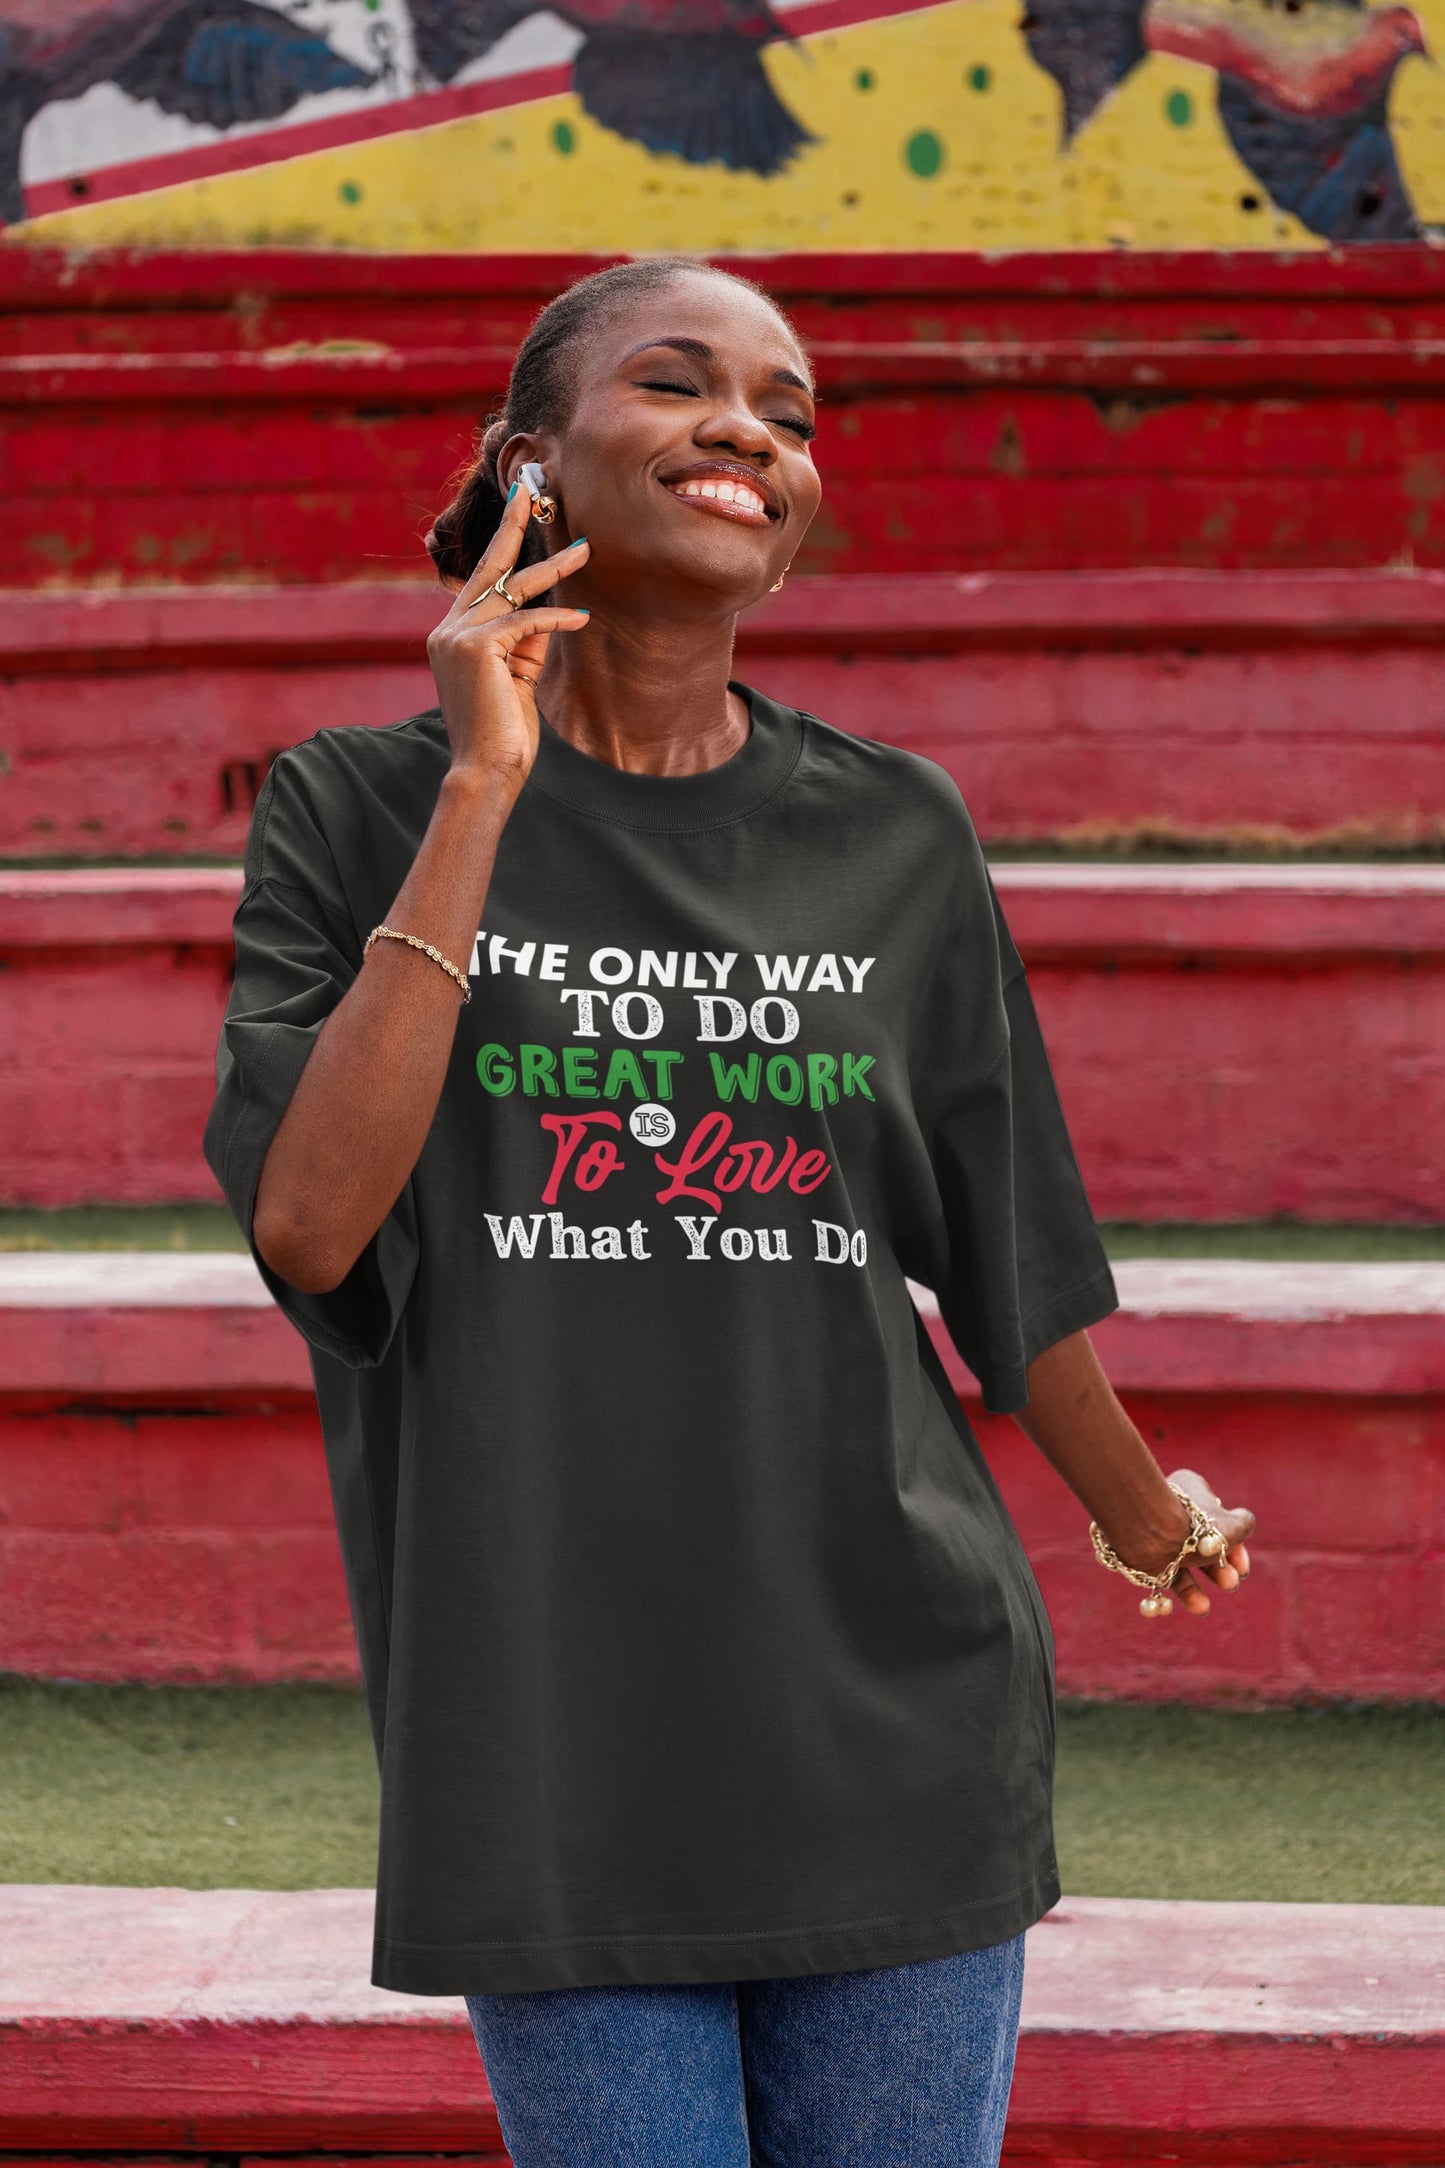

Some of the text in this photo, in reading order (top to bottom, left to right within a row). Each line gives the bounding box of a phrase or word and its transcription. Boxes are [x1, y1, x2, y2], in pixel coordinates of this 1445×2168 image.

[589, 947, 738, 989] ONLY
[754, 954, 876, 993] WAY
[560, 989, 800, 1044] TO DO
[475, 1043, 877, 1111] GREAT WORK
[540, 1111, 832, 1214] To Love
[483, 1212, 868, 1267] What You Do
